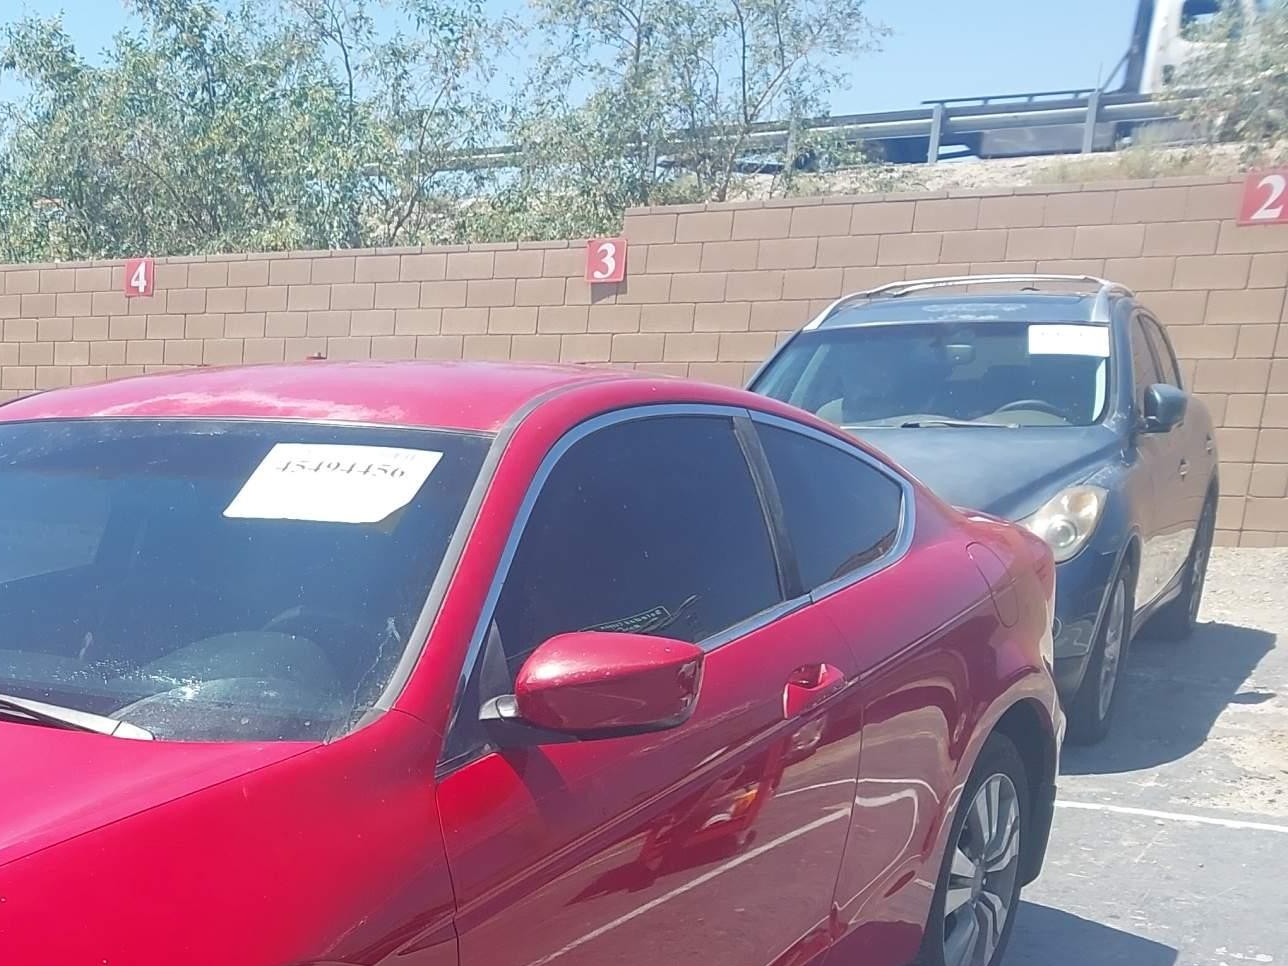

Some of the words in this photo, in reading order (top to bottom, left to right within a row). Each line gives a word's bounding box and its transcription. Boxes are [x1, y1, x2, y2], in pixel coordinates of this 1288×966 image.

[1250, 174, 1287, 220] 2
[130, 260, 148, 293] 4
[592, 242, 617, 279] 3
